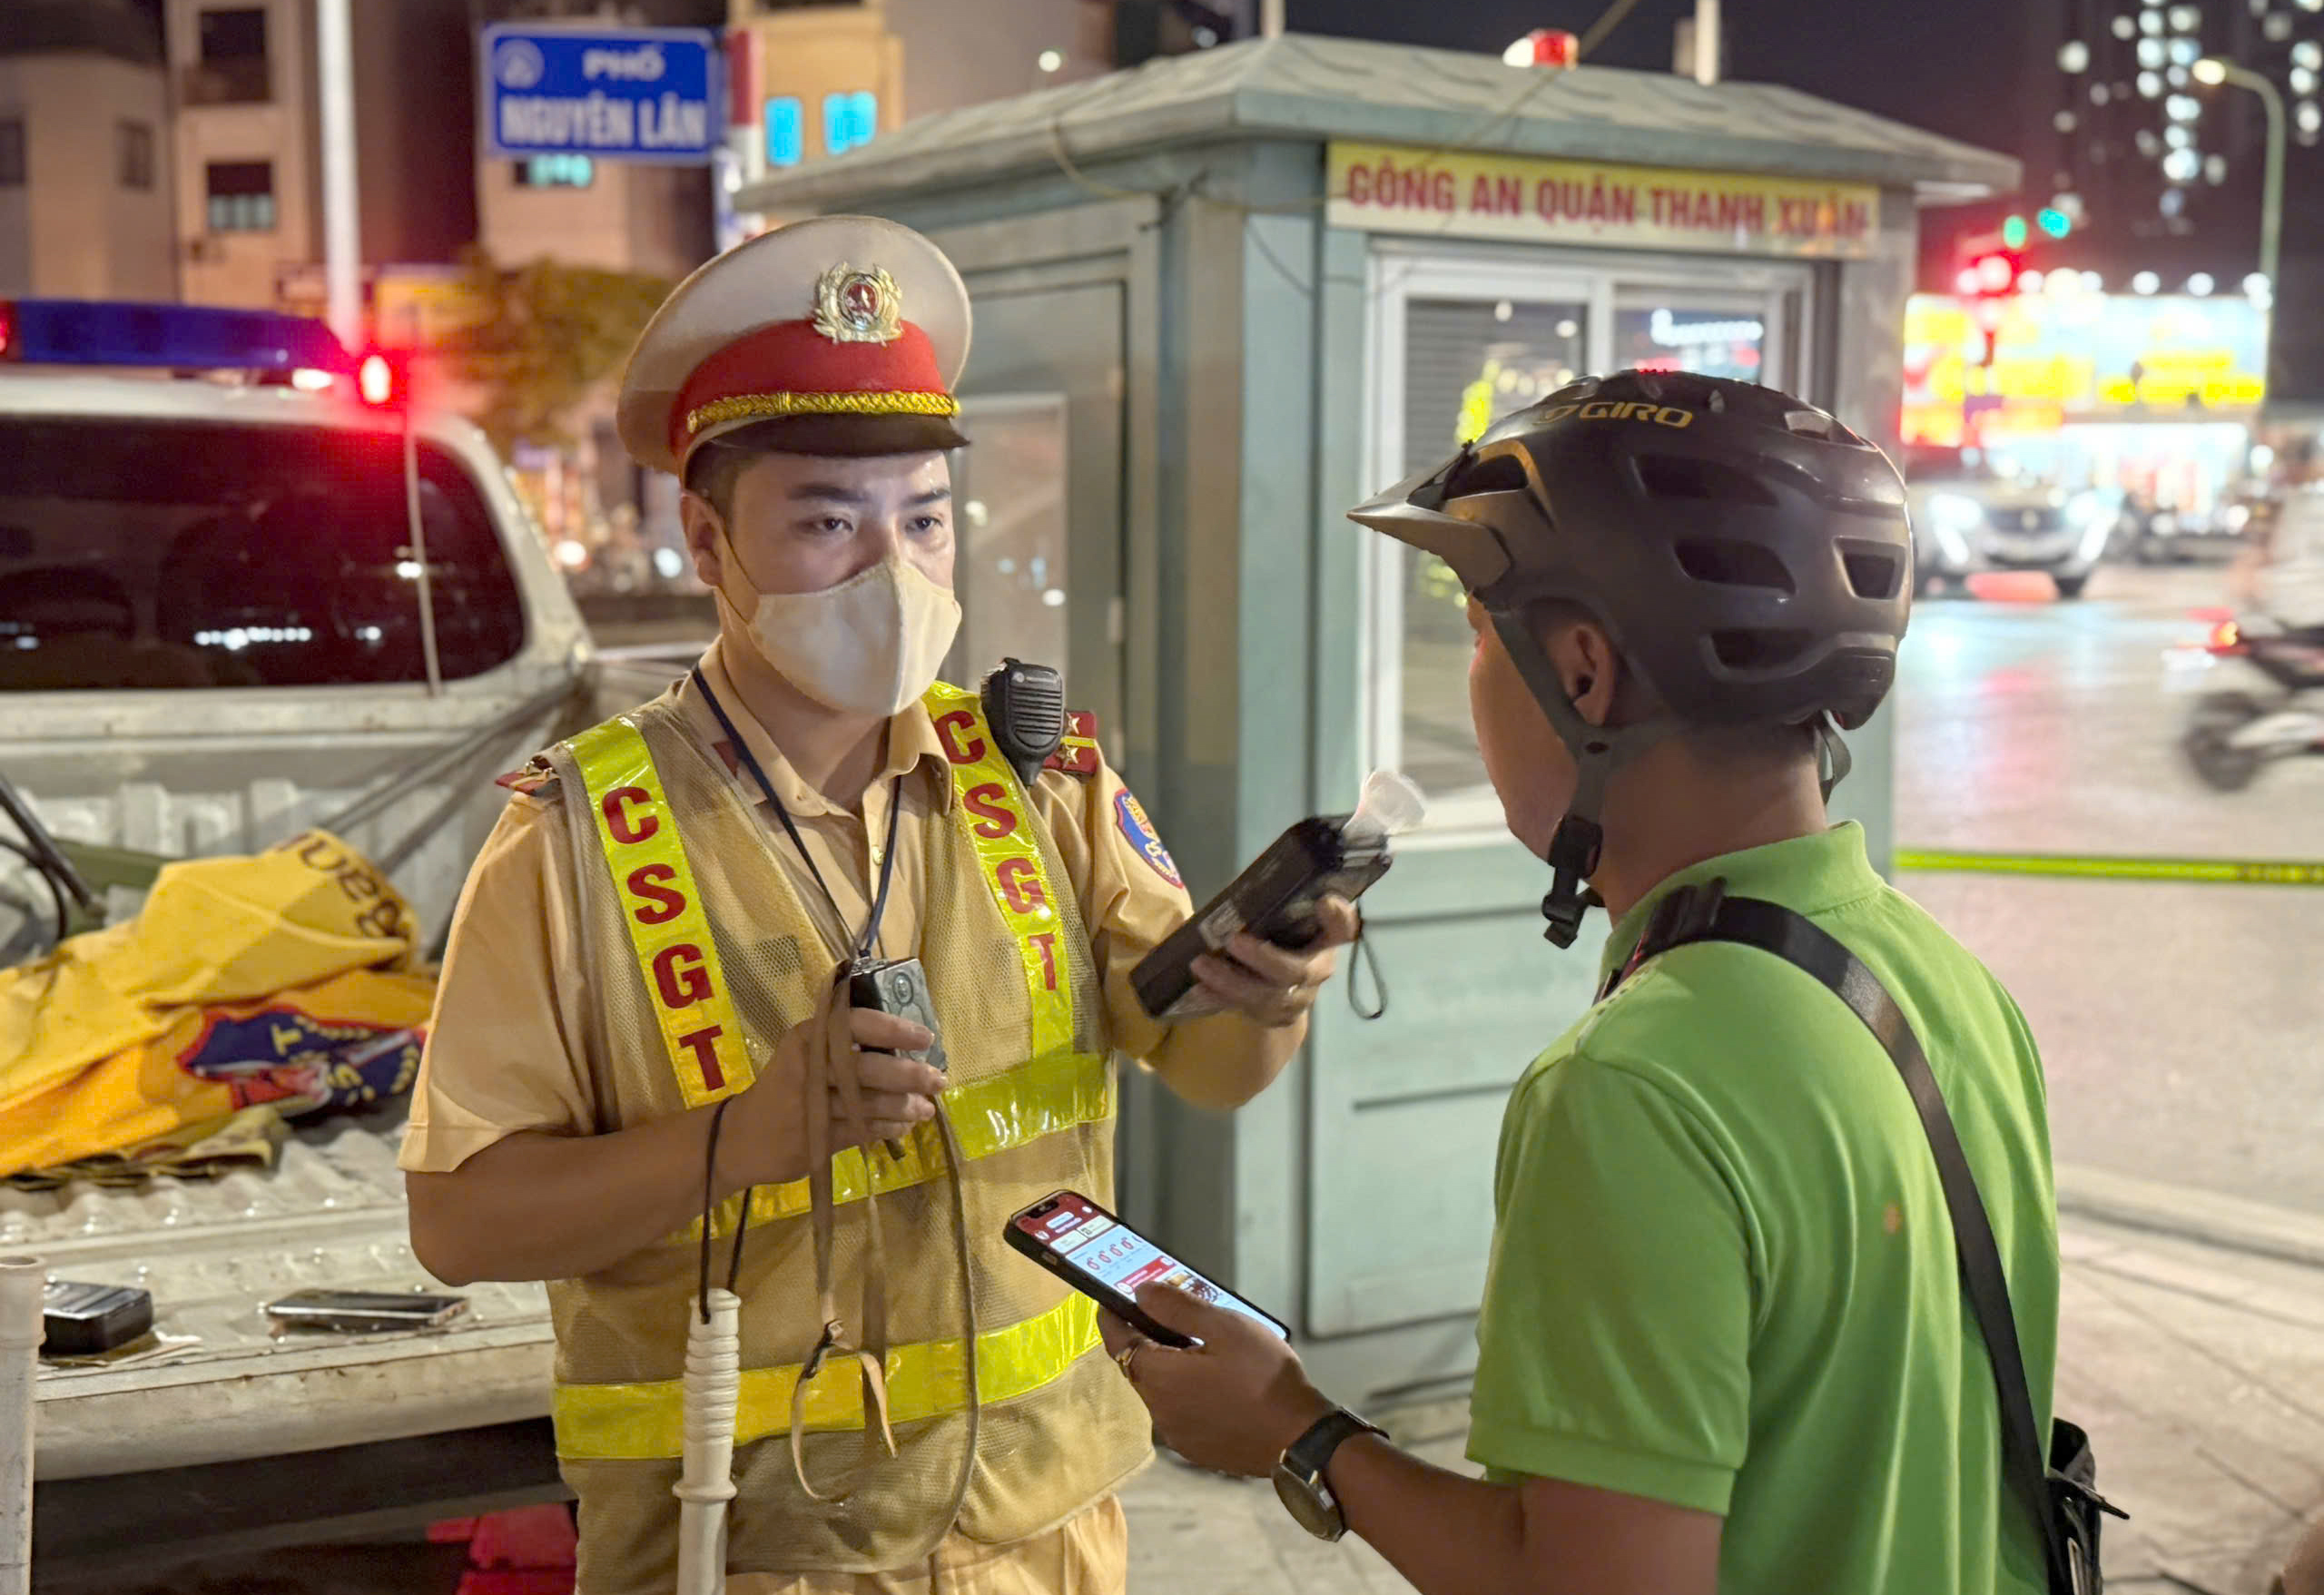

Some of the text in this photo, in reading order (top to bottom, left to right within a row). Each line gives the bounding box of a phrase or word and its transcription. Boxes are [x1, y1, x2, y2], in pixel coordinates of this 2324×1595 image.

[1470, 172, 1522, 217] AN
[1649, 186, 1764, 234] THANH
[1580, 401, 1693, 428] GIRO
[933, 710, 1057, 991] CSGT
[601, 786, 726, 1091] CSGT
